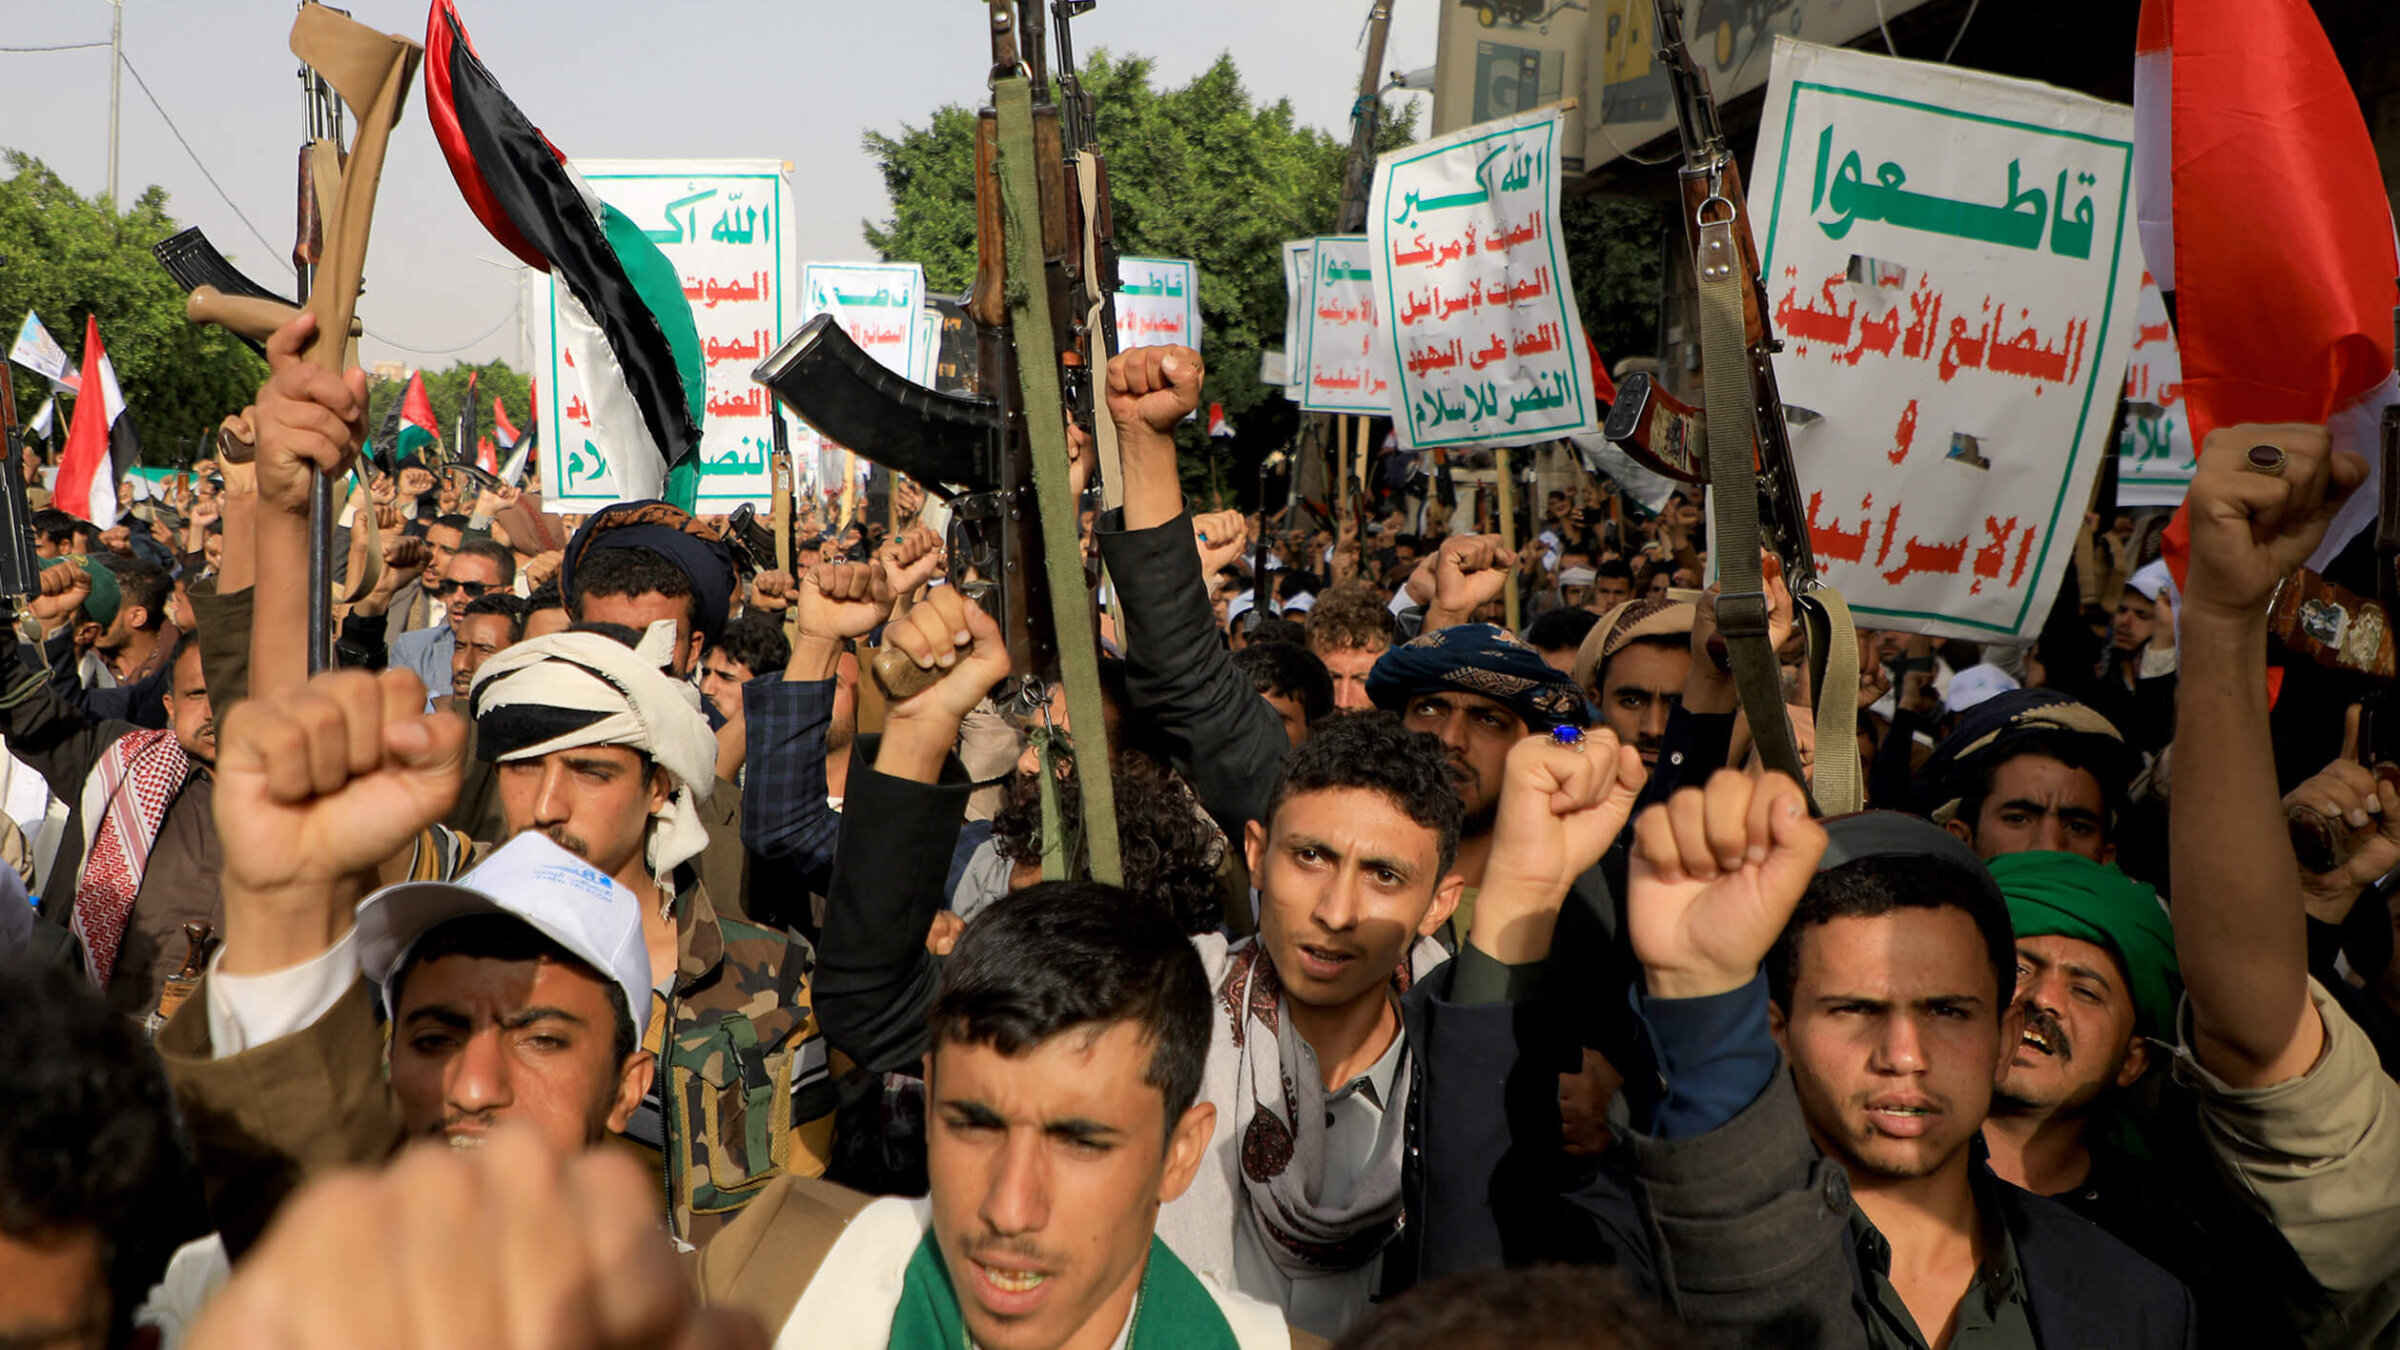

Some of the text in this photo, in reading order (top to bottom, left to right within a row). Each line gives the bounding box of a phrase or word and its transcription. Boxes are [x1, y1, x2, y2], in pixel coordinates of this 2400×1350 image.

[645, 182, 770, 246] الله أك
[1393, 142, 1542, 229] الله أكبر
[1810, 123, 2095, 260] قاطعوا
[1321, 252, 1372, 288] عوا
[1393, 208, 1541, 270] الموت لأمريكا
[1119, 271, 1183, 297] قاط
[1400, 278, 1482, 326] لإسرائيل
[1486, 265, 1549, 310] الموت
[701, 328, 770, 368] المو
[1407, 320, 1561, 379] اللعنة على اليهود
[1774, 269, 1943, 367] الأمريكية
[1938, 293, 2089, 398] البضائع
[706, 385, 771, 417] اللعنة
[1415, 368, 1572, 437] النصر للإسلام
[1887, 399, 1919, 466] و
[1804, 489, 2036, 596] الإسرائيل
